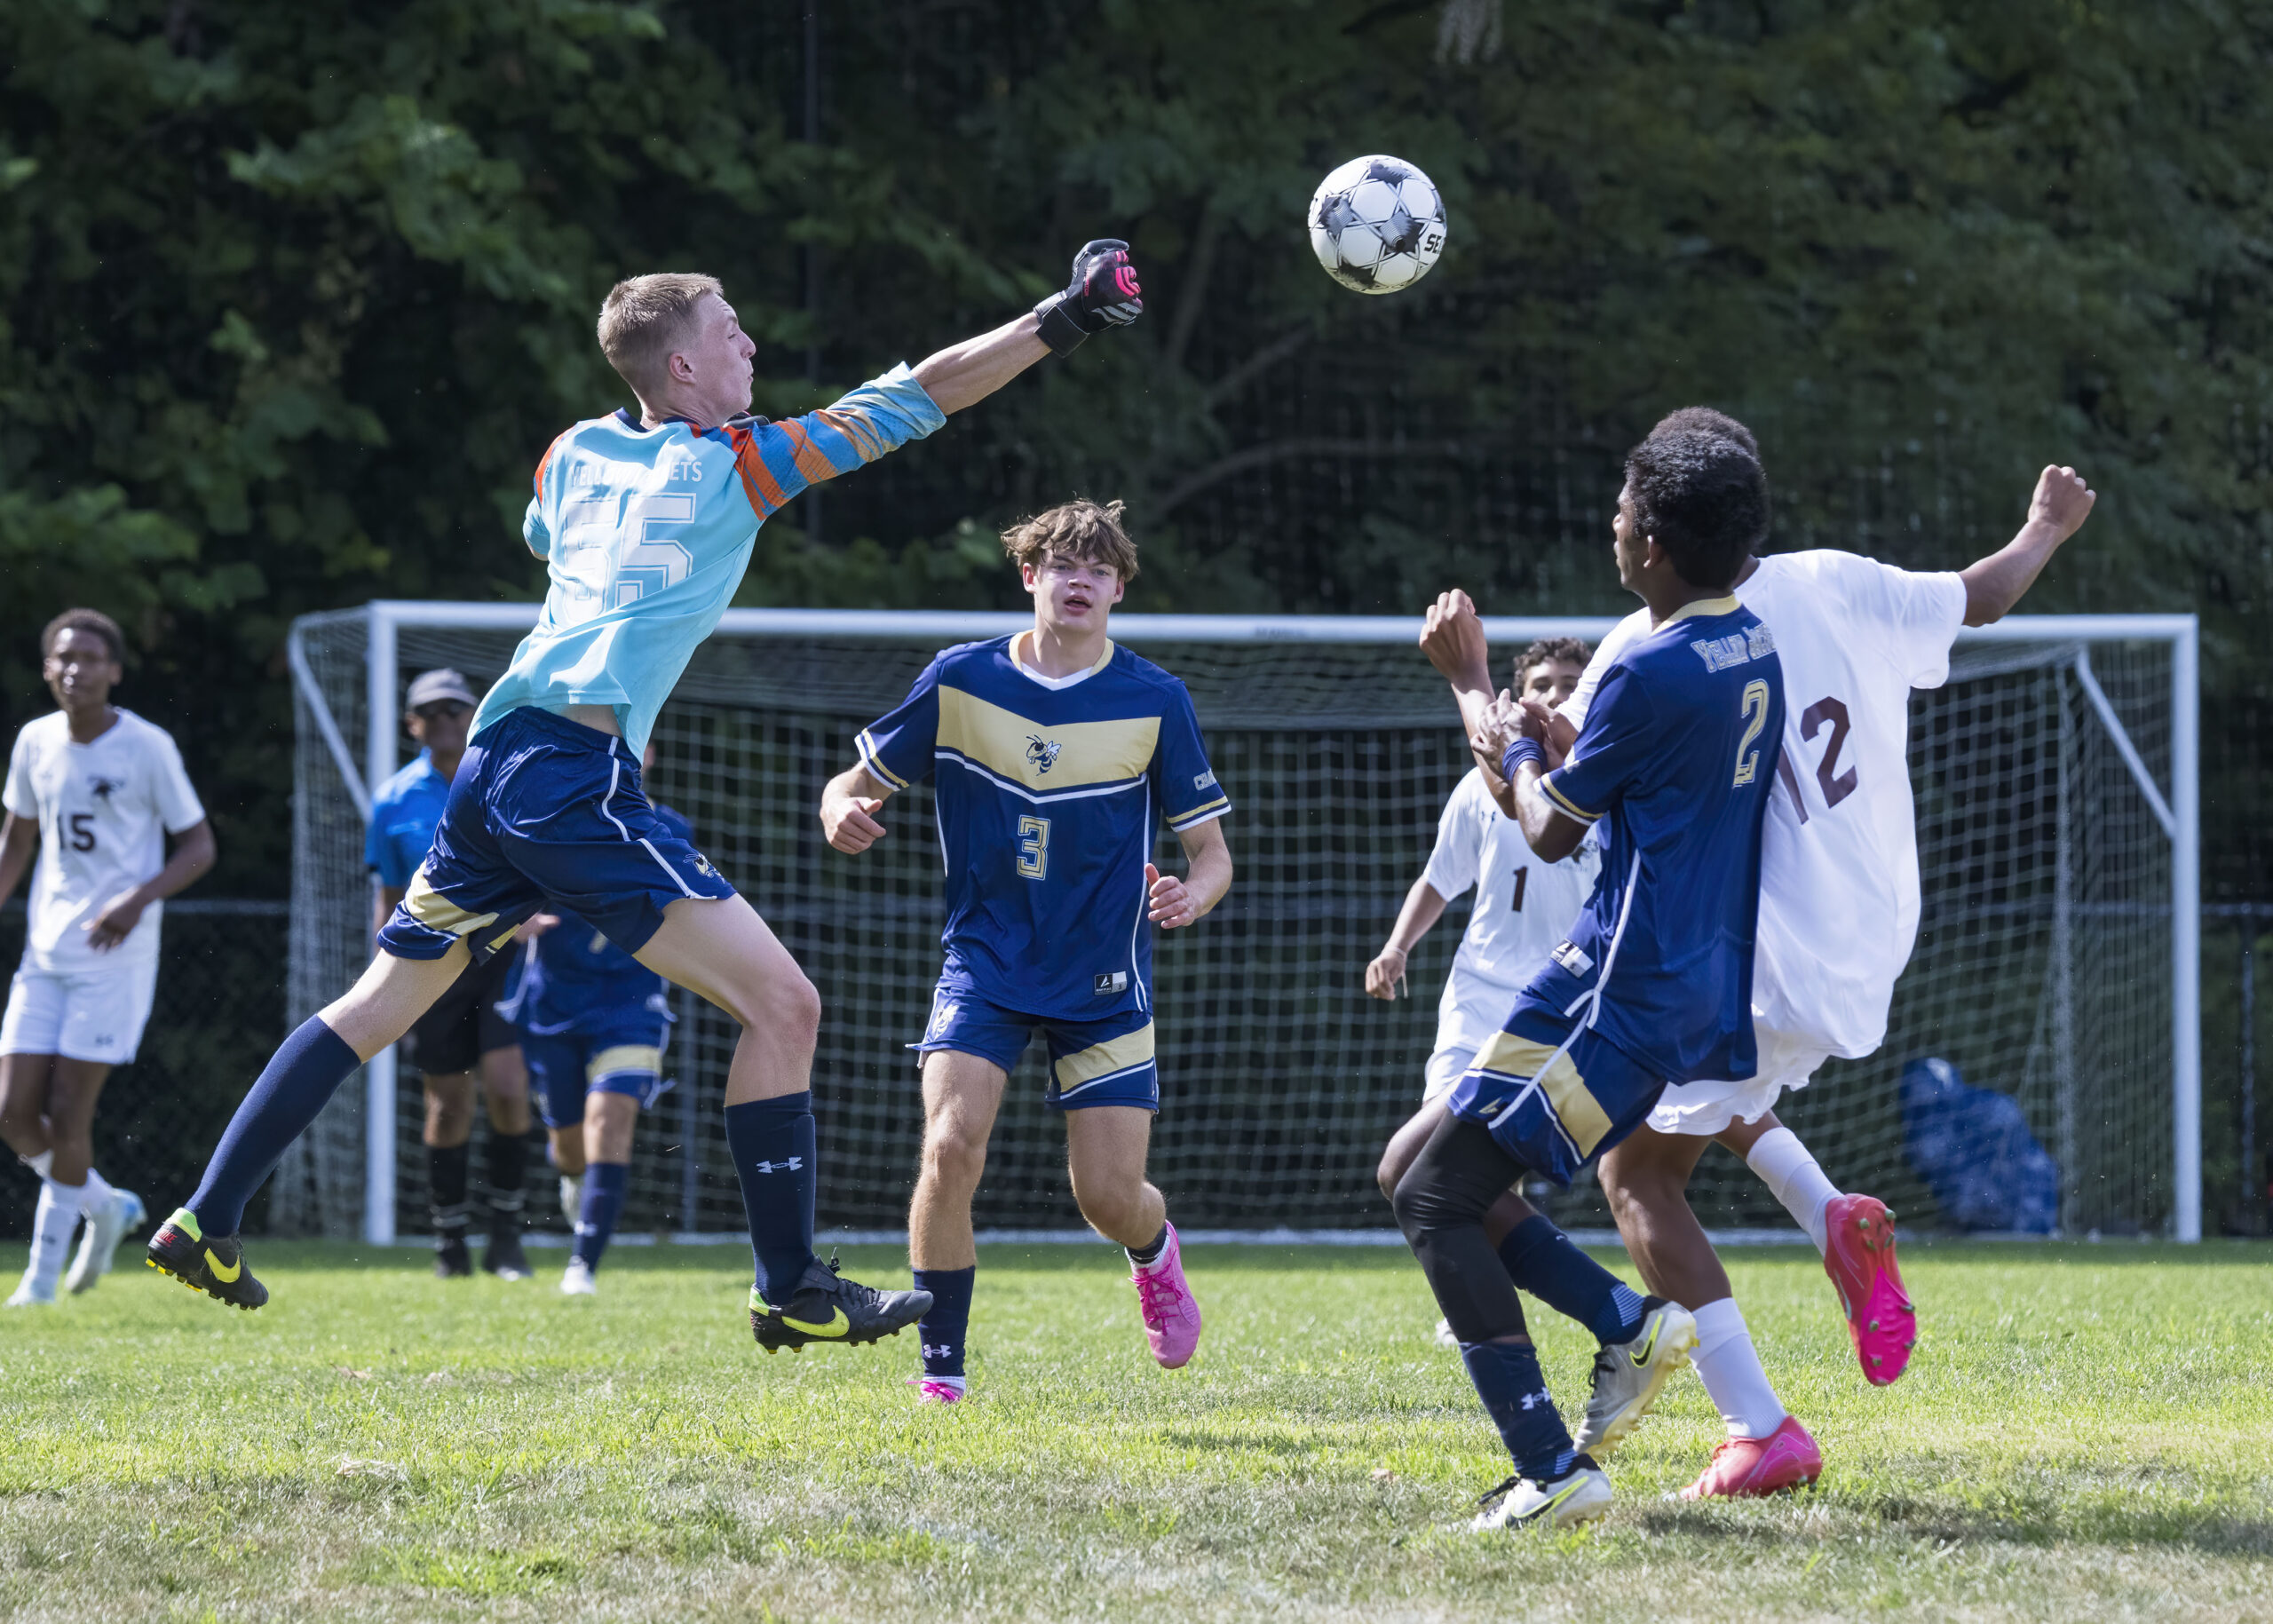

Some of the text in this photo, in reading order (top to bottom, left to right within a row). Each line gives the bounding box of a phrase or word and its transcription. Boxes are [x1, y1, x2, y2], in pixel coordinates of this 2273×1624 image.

[1423, 233, 1445, 255] SE
[563, 492, 697, 620] 55
[1732, 678, 1770, 789] 2
[1776, 695, 1858, 825] 12
[58, 813, 96, 852] 15
[1017, 814, 1051, 881] 3
[1512, 866, 1528, 913] 1
